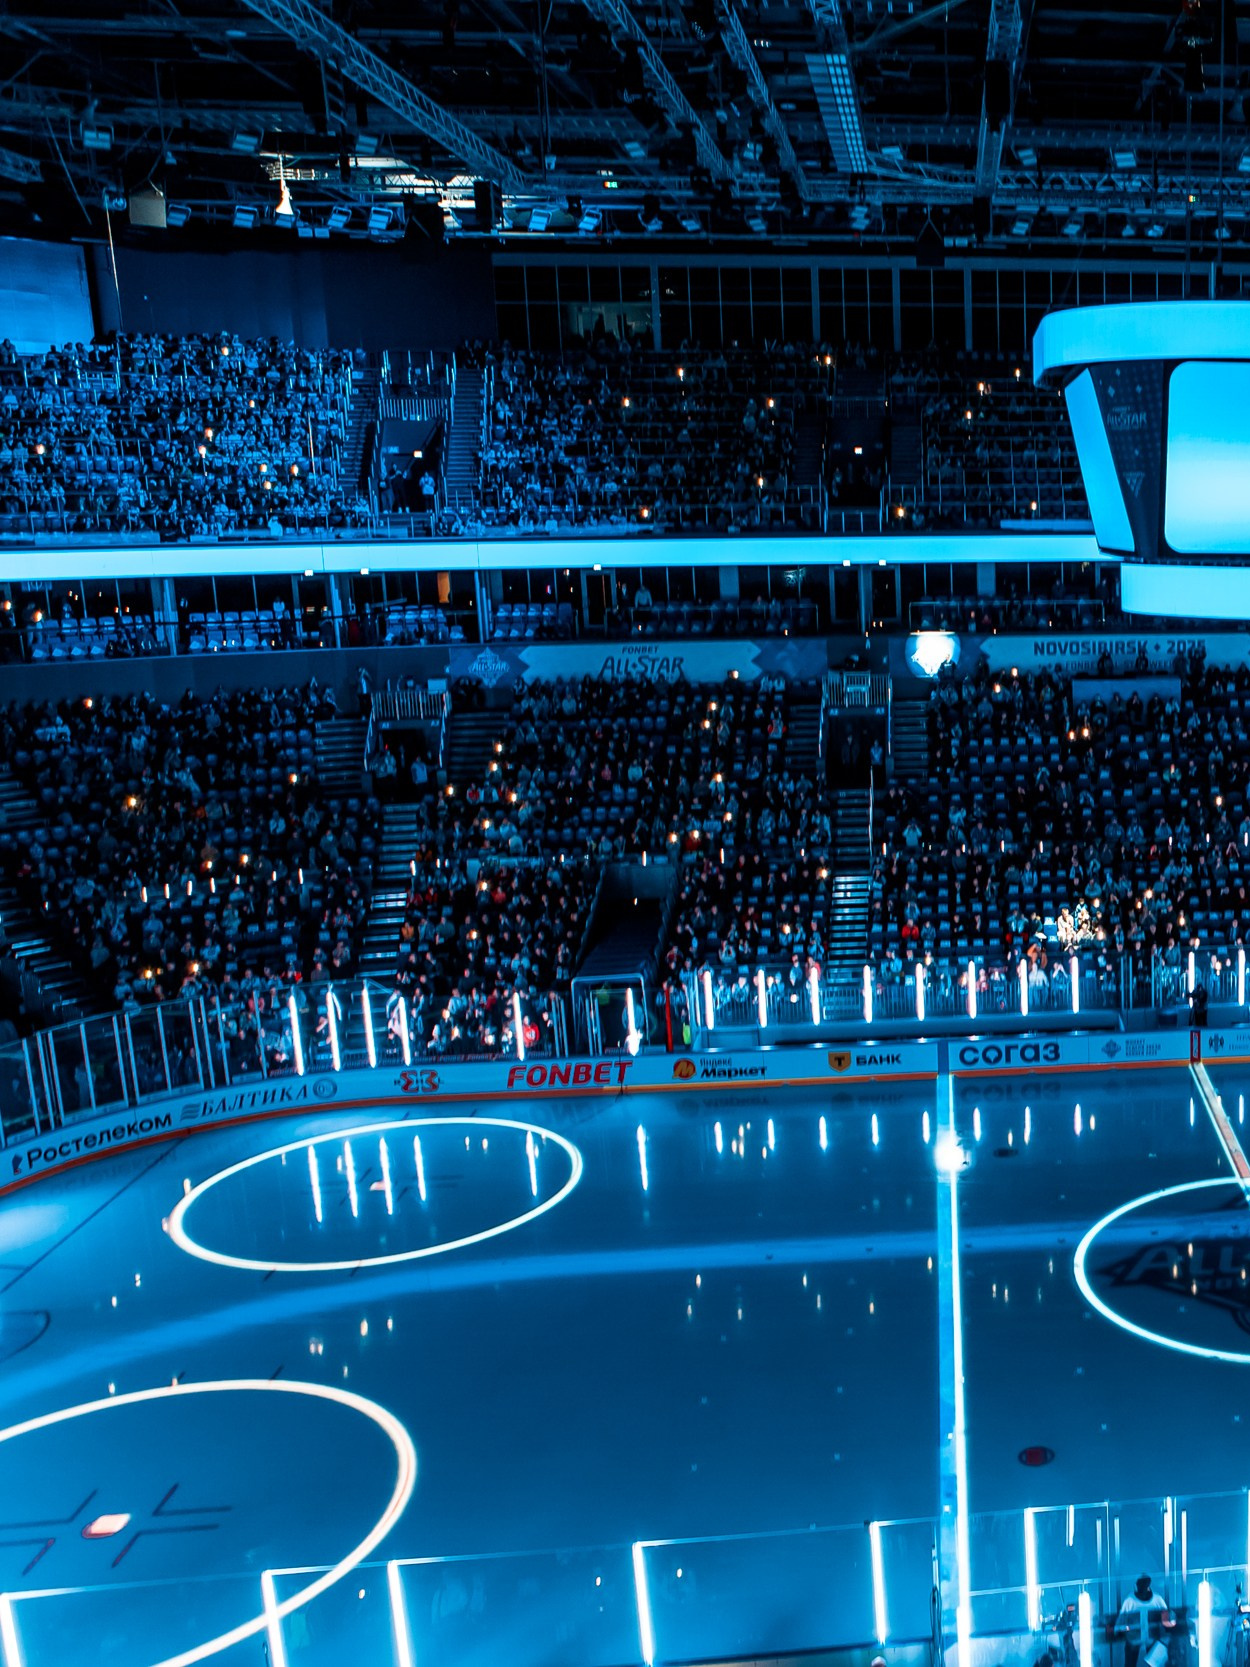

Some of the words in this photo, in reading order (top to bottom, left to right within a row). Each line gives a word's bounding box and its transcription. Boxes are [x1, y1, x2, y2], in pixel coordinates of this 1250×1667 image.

[621, 645, 659, 654] FONBET
[1033, 640, 1148, 656] NOVOSIBIRSK
[856, 1053, 901, 1067] БАНК
[507, 1060, 633, 1089] FONBET
[700, 1066, 767, 1079] Маркет
[200, 1084, 308, 1117] БАЛТИКА
[28, 1113, 172, 1169] Ростелеком
